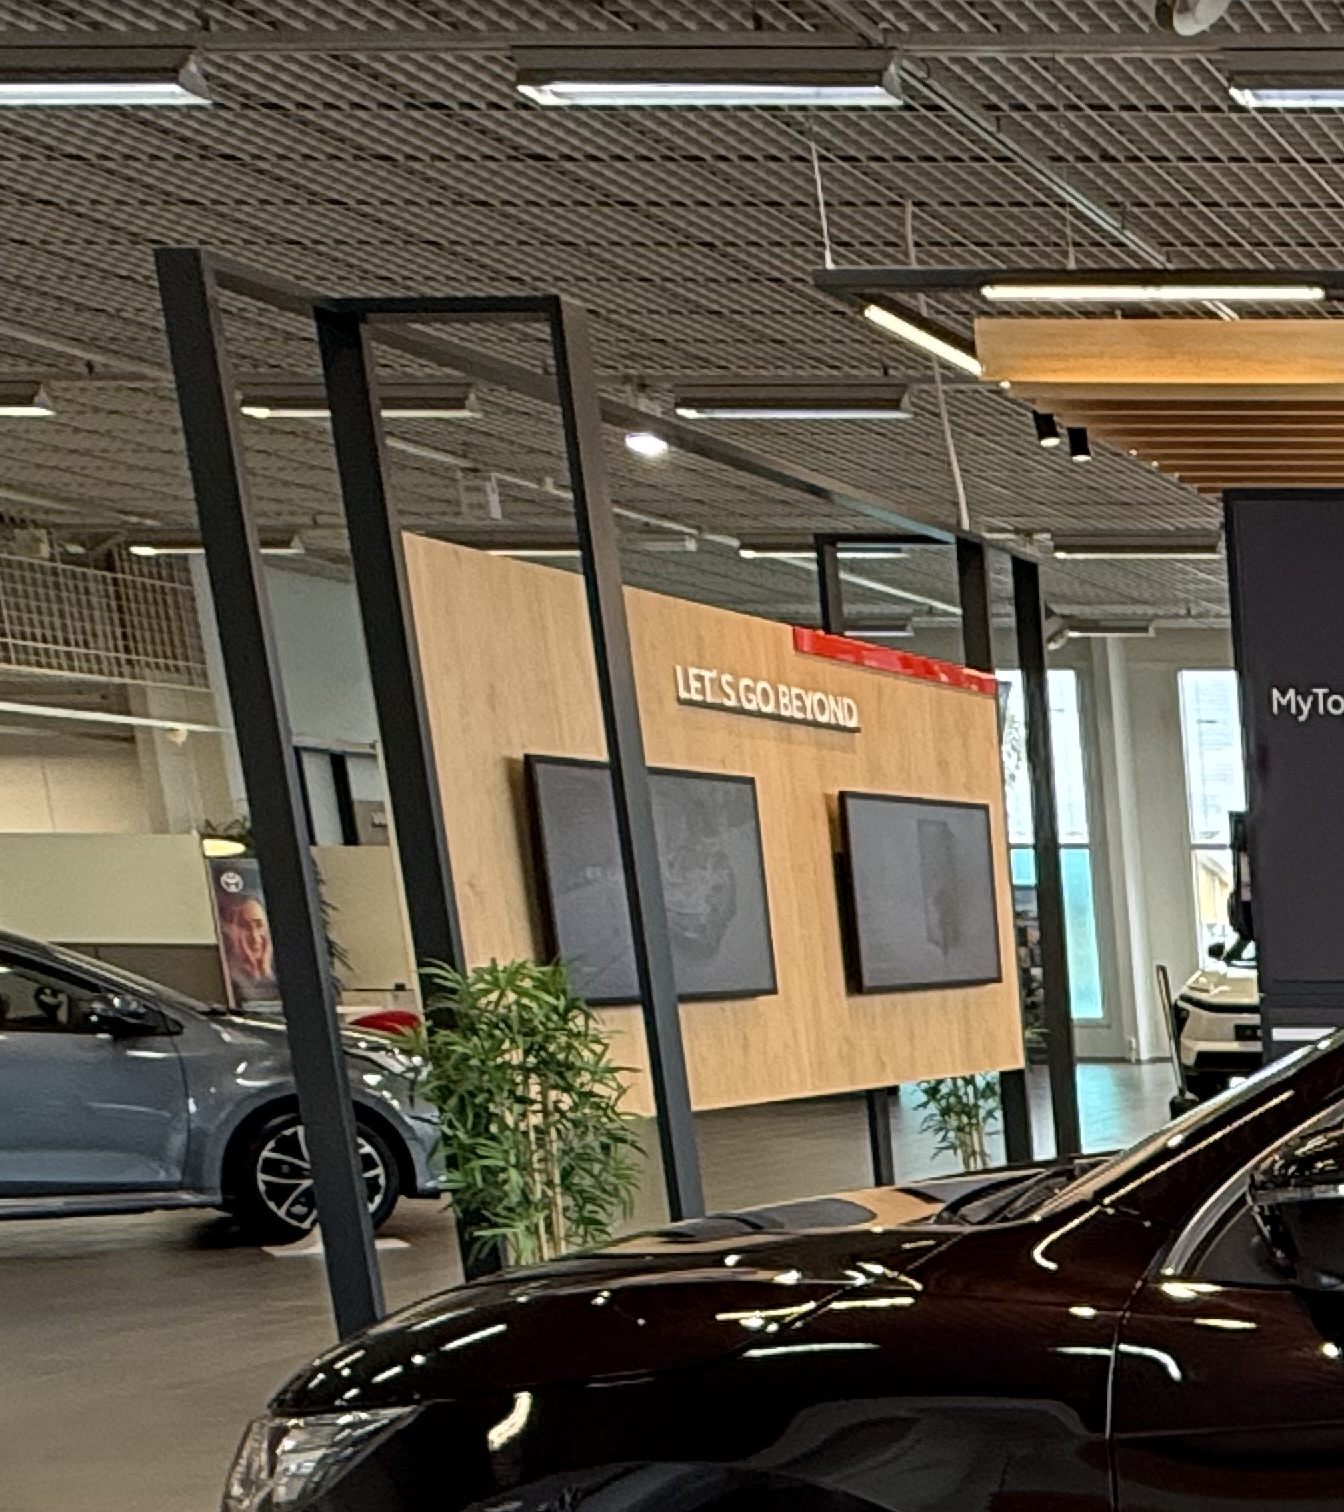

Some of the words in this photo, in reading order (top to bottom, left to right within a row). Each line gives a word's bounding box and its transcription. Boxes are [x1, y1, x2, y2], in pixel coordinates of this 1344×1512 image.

[674, 664, 737, 706] LET'S
[738, 677, 776, 713] GO
[777, 683, 859, 728] BEYOND
